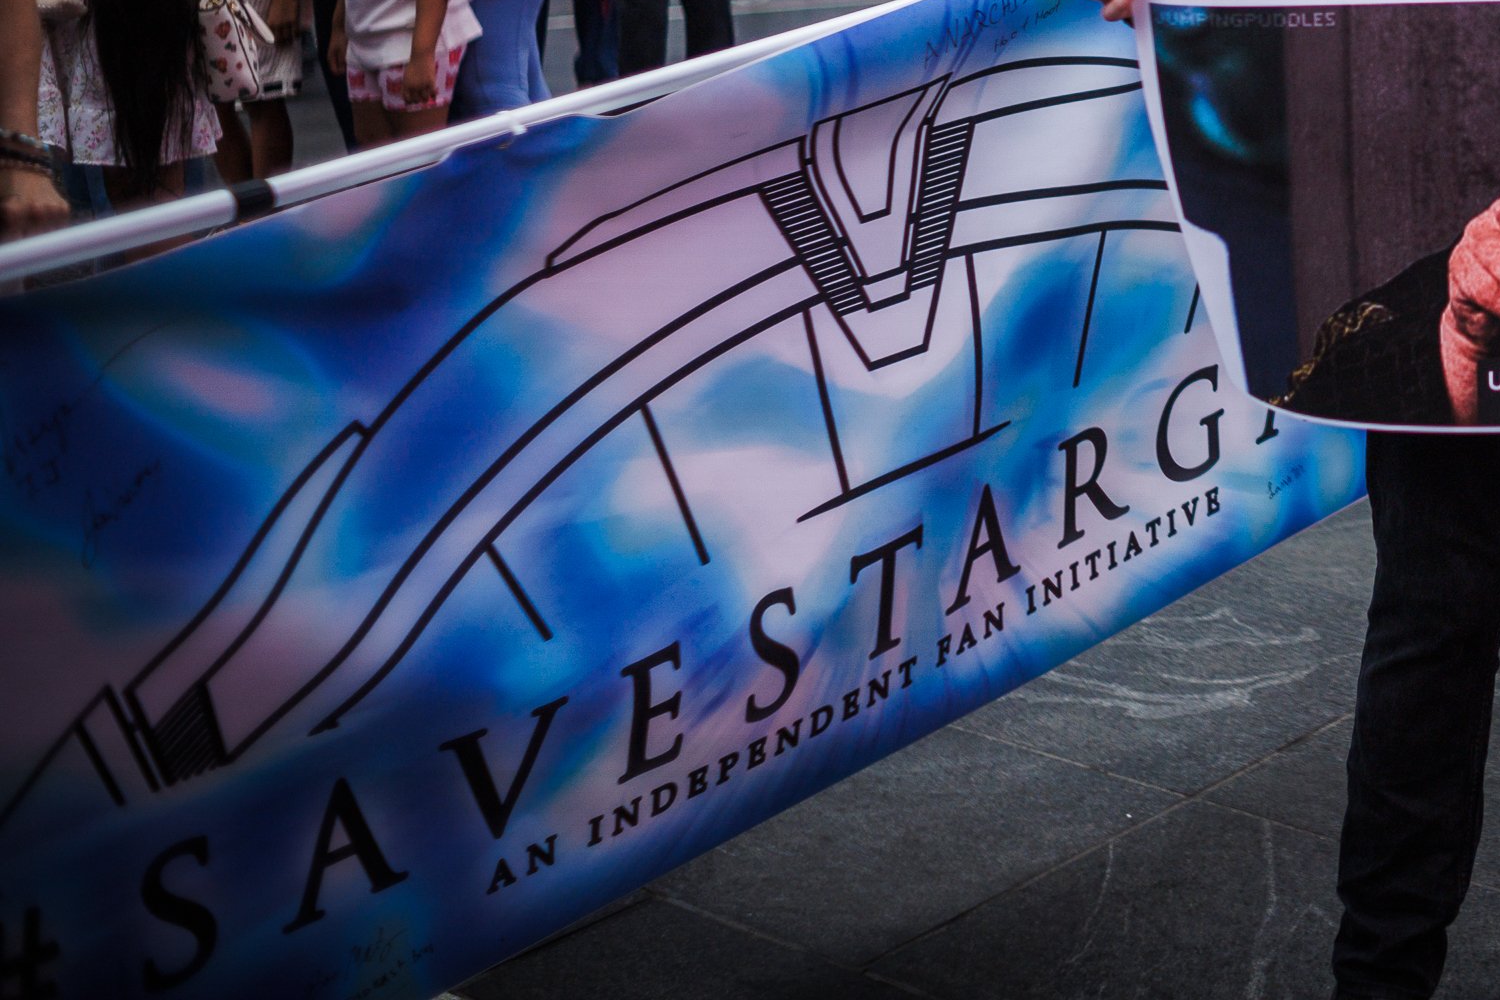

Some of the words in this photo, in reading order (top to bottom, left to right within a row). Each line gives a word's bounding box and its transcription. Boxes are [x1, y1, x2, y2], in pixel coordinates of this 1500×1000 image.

[1155, 11, 1336, 29] JUMPINGPUDDLES
[0, 363, 1281, 999] #SAVESTARG
[486, 834, 559, 895] AN
[587, 656, 919, 848] INDEPENDENT
[934, 602, 1006, 669] FAN
[1025, 486, 1222, 617] INITIATIVE
